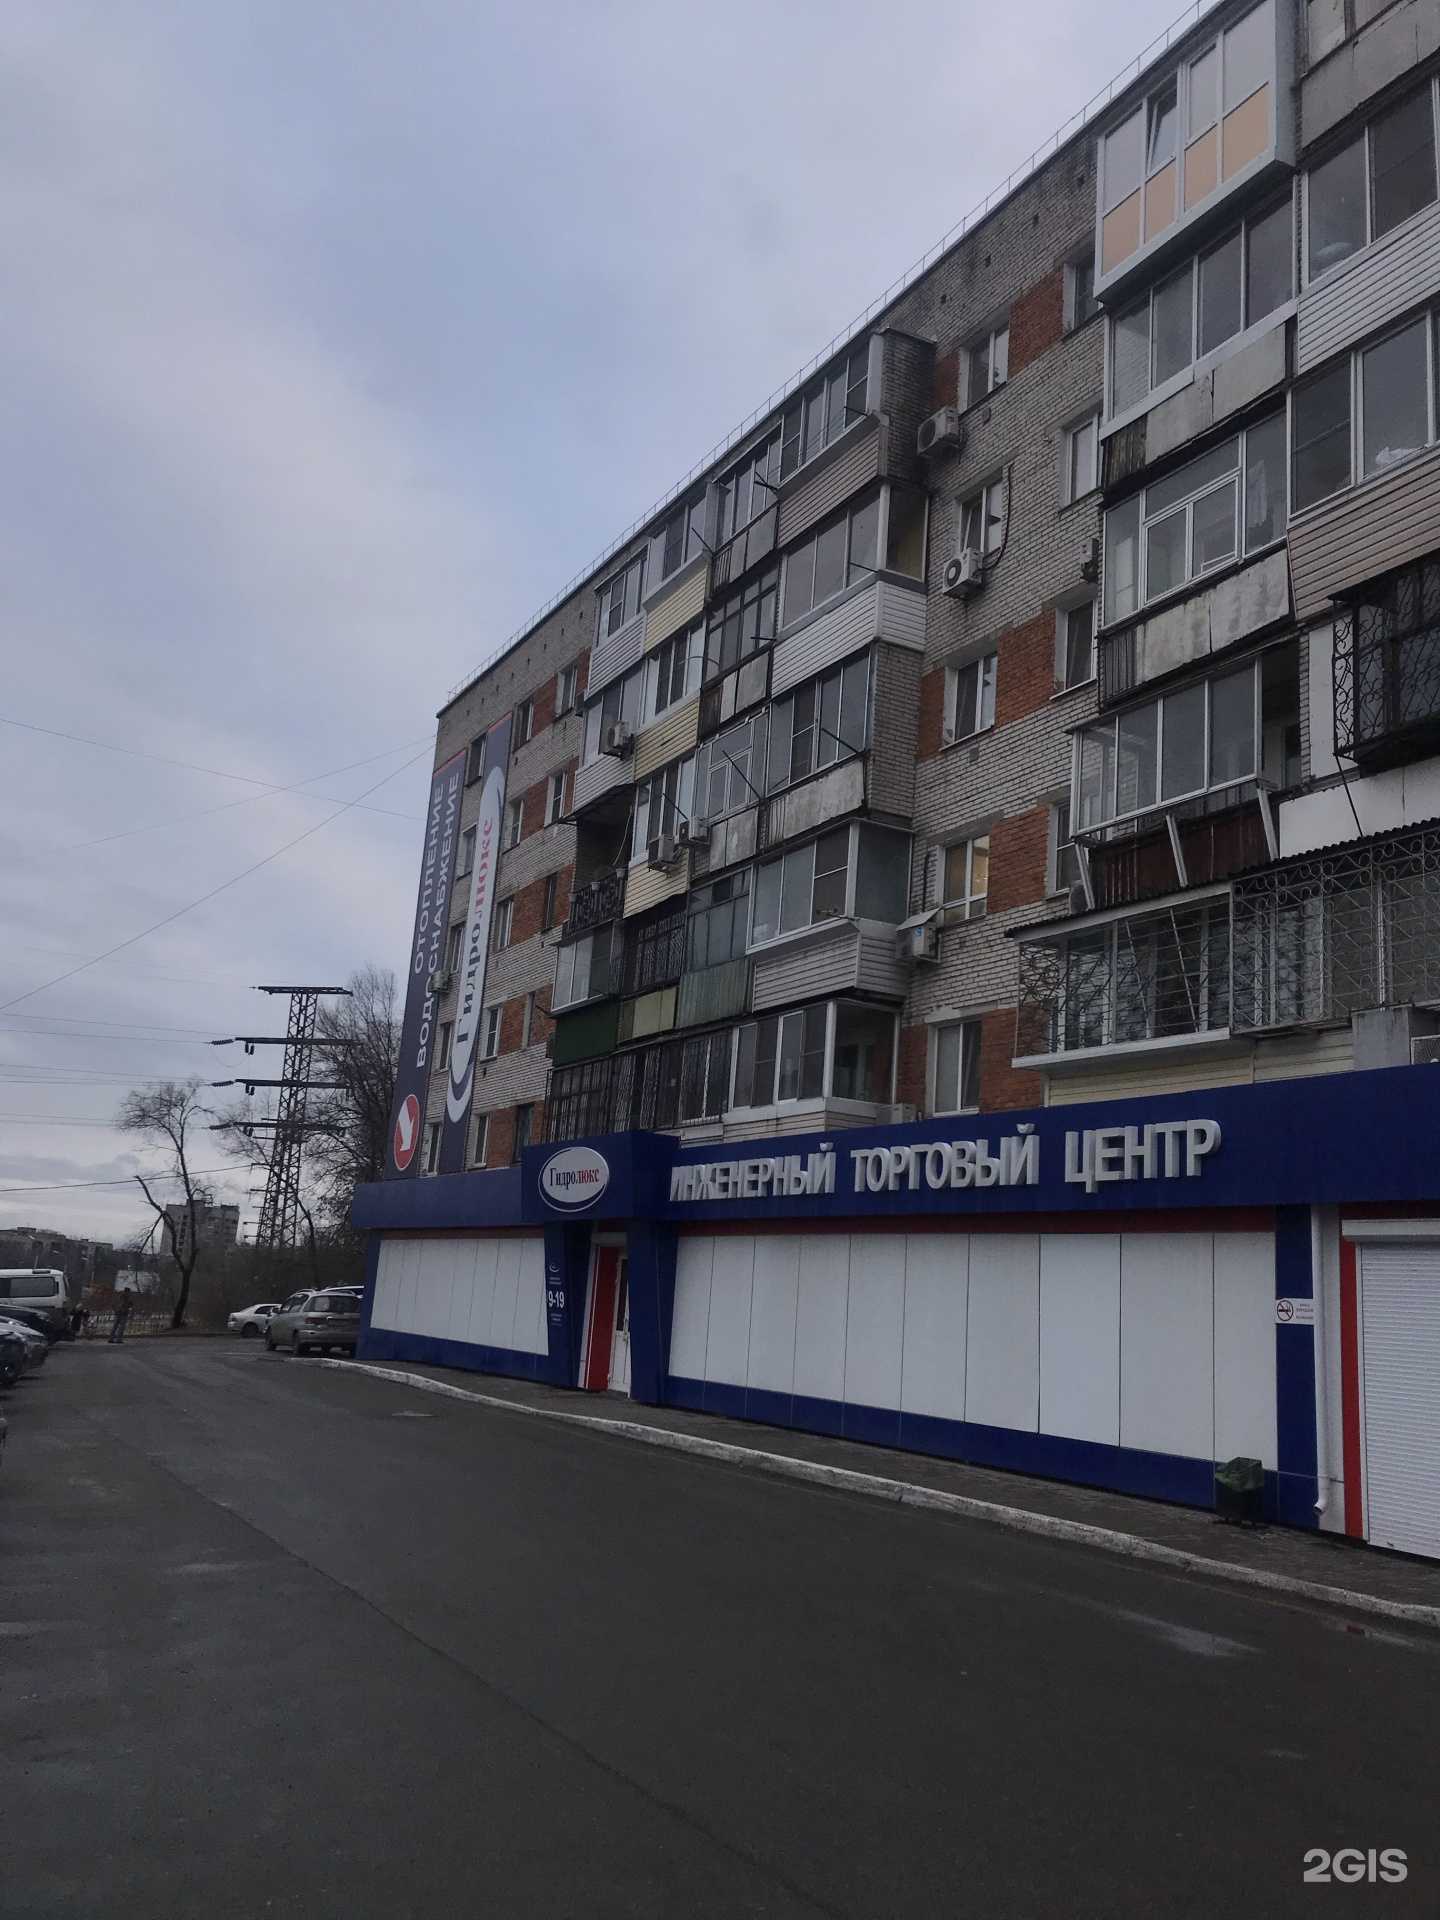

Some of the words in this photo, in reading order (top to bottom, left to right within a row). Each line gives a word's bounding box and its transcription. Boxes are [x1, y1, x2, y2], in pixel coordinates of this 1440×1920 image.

[414, 784, 444, 974] ОТОПЛЕНИЕ
[549, 1167, 600, 1190] Гидролюкс
[670, 1142, 837, 1201] ИНЖЕНЕРНЫЙ
[851, 1123, 1040, 1192] ТОРГОВЫЙ
[1065, 1119, 1221, 1193] ЦЕНТР
[548, 1290, 565, 1309] 9-19
